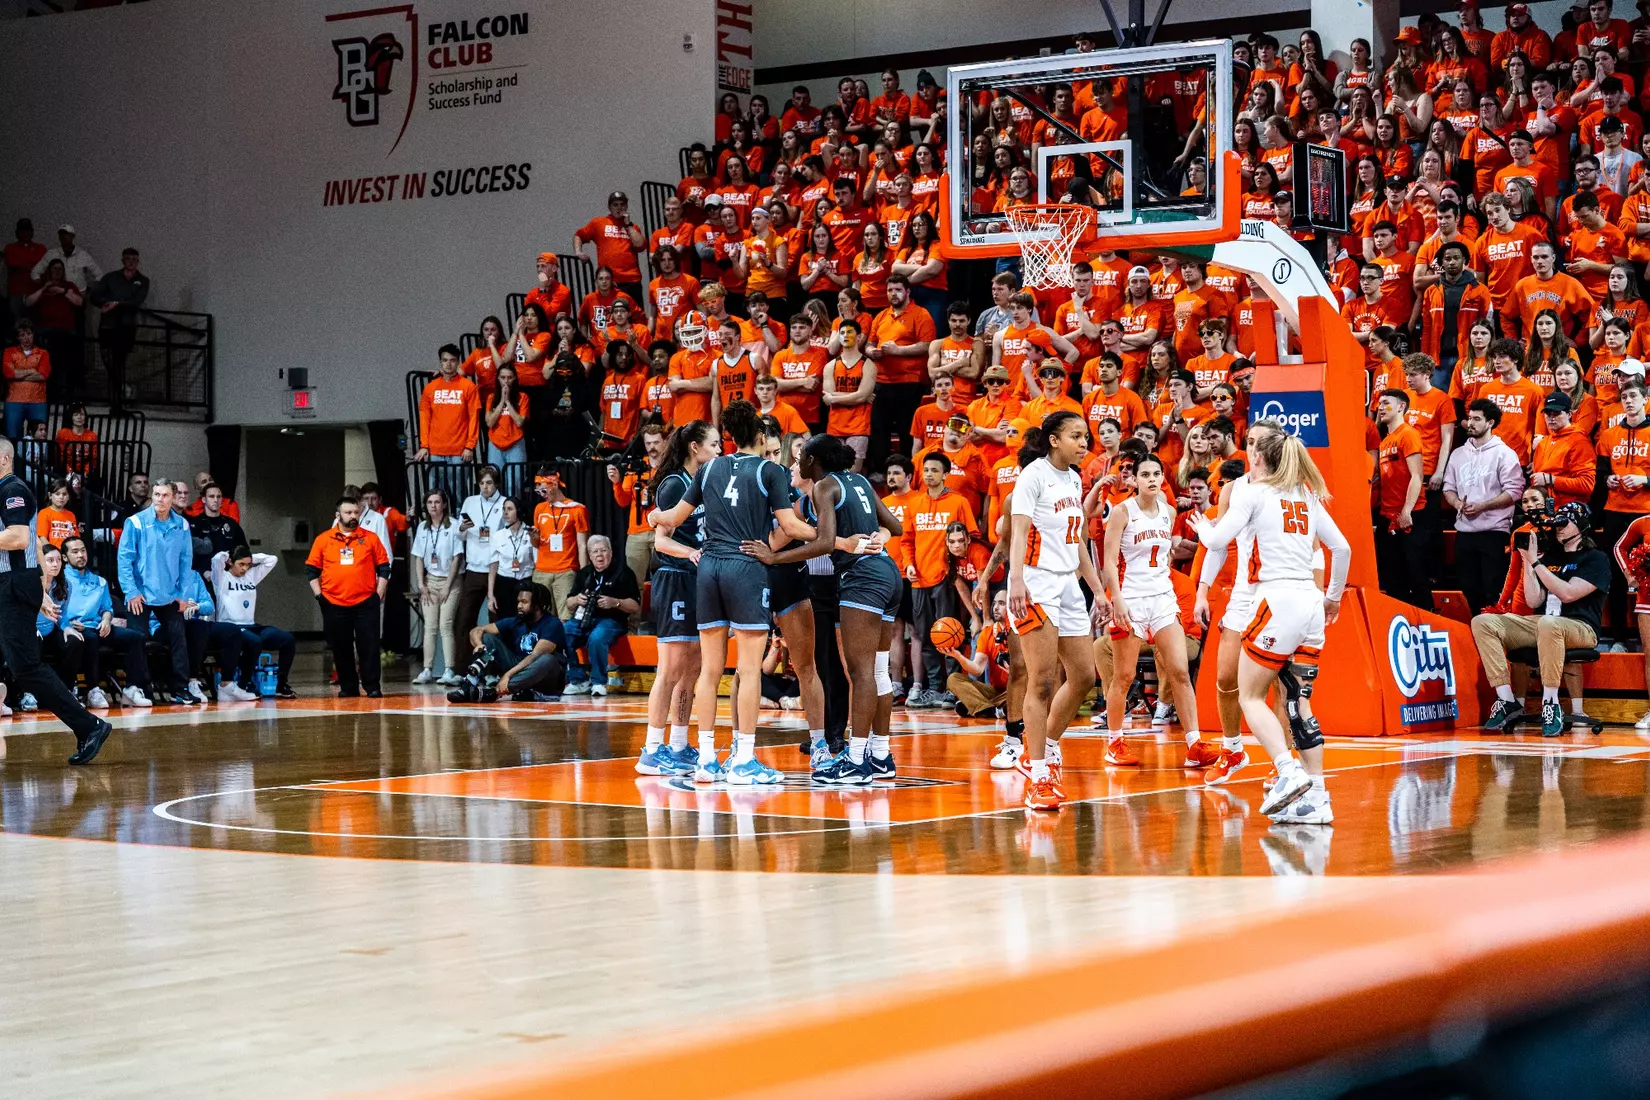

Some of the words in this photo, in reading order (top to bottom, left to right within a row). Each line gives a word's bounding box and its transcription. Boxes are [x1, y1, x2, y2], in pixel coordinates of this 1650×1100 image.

[428, 12, 529, 45] FALCON
[428, 42, 493, 68] CLUB
[726, 65, 751, 89] EDGE
[428, 77, 492, 96] Scholarship
[495, 73, 518, 89] and
[428, 94, 470, 111] Success
[474, 90, 502, 106] Fund
[323, 174, 399, 206] INVEST
[402, 172, 427, 200] IN
[431, 163, 532, 197] SUCCESS
[913, 180, 939, 188] BEAT
[959, 236, 985, 244] SPALDING
[1488, 240, 1523, 255] BEAT
[1489, 251, 1523, 261] COLUMBIA
[1205, 276, 1237, 286] BEAT
[1066, 311, 1094, 321] BET
[1004, 339, 1027, 349] BEA
[721, 373, 746, 386] FALCON
[836, 376, 861, 387] FALCON
[1195, 370, 1227, 381] BEAT
[434, 389, 463, 398] BEAT
[1487, 394, 1524, 406] BEAT
[1091, 405, 1123, 416] BEAT
[1162, 415, 1194, 426] BT
[1620, 437, 1629, 445] be
[1612, 443, 1649, 459] good
[997, 467, 1020, 478] BEA
[723, 476, 739, 507] 4
[853, 486, 871, 514] 5
[1054, 500, 1075, 513] BOWLING
[915, 512, 950, 524] BEAT
[1280, 499, 1308, 535] 25
[916, 523, 948, 531] COLUMBIA
[1066, 516, 1080, 544] 11
[1134, 532, 1158, 544] BOWLING
[1149, 545, 1160, 567] 1
[672, 601, 685, 620] C
[1388, 614, 1456, 697] City
[1403, 704, 1437, 723] DELIVERING
